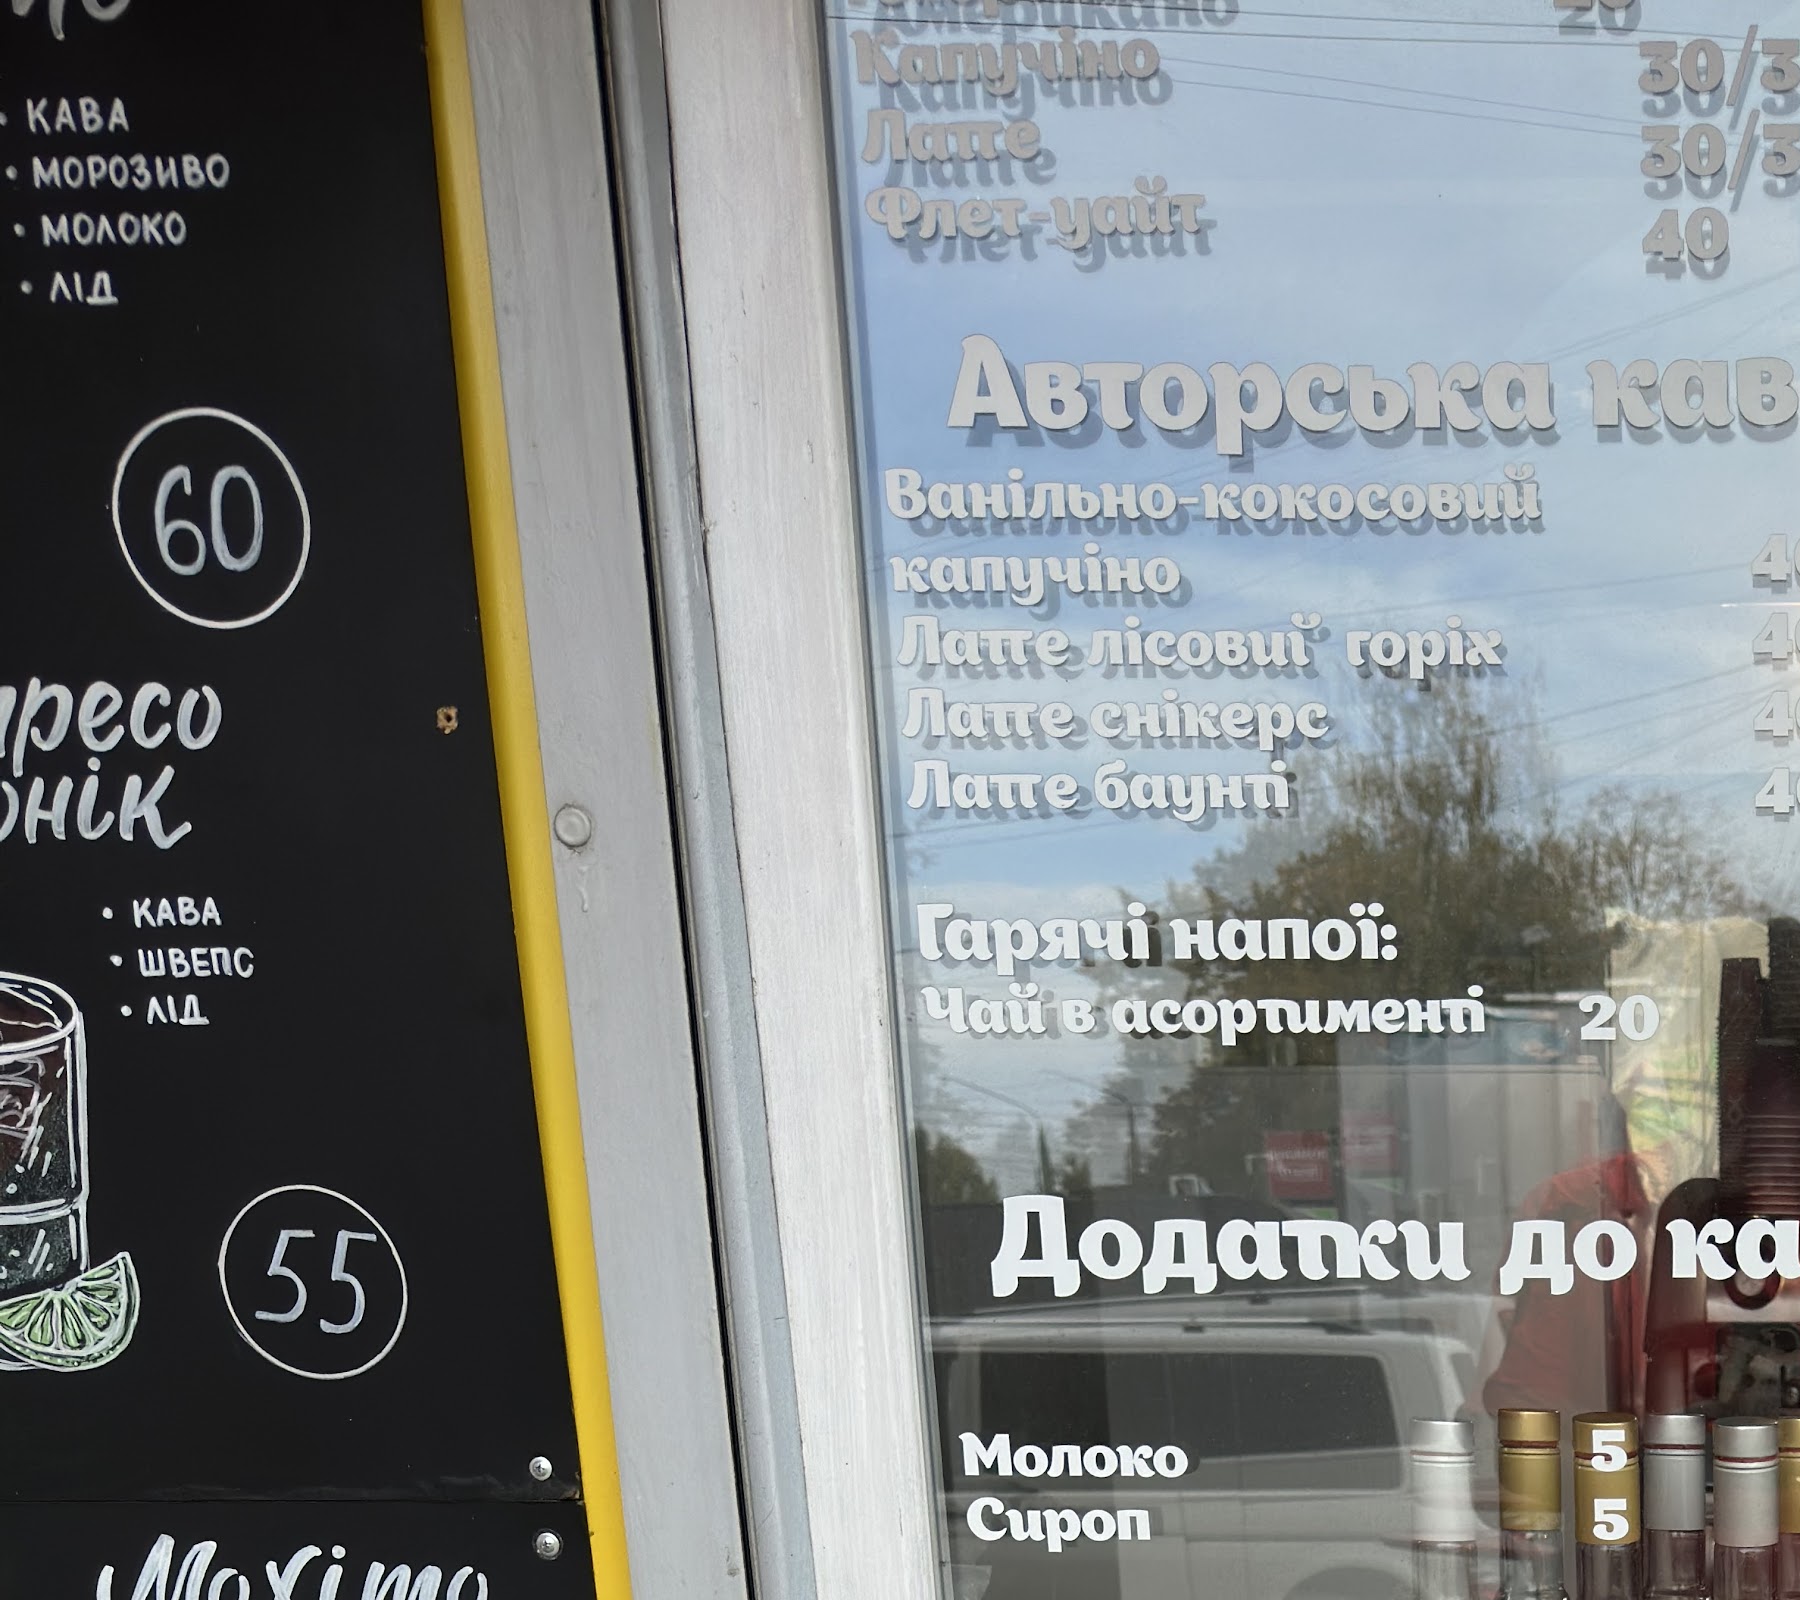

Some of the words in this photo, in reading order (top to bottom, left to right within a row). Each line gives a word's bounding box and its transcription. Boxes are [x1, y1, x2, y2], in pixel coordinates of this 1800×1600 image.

[850, 27, 1160, 96] Капучіно
[26, 97, 130, 133] КАВА
[33, 153, 230, 190] МОРОЗИВО
[41, 212, 187, 246] МОЛОКО
[865, 176, 1206, 250] Флет-уайт
[1642, 207, 1729, 261] 40
[50, 270, 118, 304] ЛІД
[947, 333, 1556, 456] Авторська
[154, 465, 263, 575] 60
[884, 462, 1542, 520] Ванільно-кокосовий
[890, 543, 1181, 606] капучіно
[1346, 615, 1502, 679] горіх
[1090, 688, 1330, 752] снікерс
[1094, 759, 1290, 823] баунті
[133, 897, 221, 927] КАВА
[916, 902, 1149, 976] Гарячі
[1169, 902, 1399, 962] напої:
[137, 947, 254, 979] ШВЕПС
[146, 994, 209, 1025] ЛІД
[921, 983, 1047, 1035] Чай
[1063, 997, 1096, 1034] в
[1111, 984, 1486, 1047] асортименті
[1578, 993, 1659, 1042] 20
[990, 1194, 1471, 1298] Додатки
[1500, 1218, 1638, 1296] до
[255, 1229, 377, 1335] 55
[958, 1431, 1190, 1480] Молоко
[1591, 1429, 1628, 1474] 5
[966, 1496, 1151, 1553] Сироп
[1592, 1498, 1629, 1542] 5
